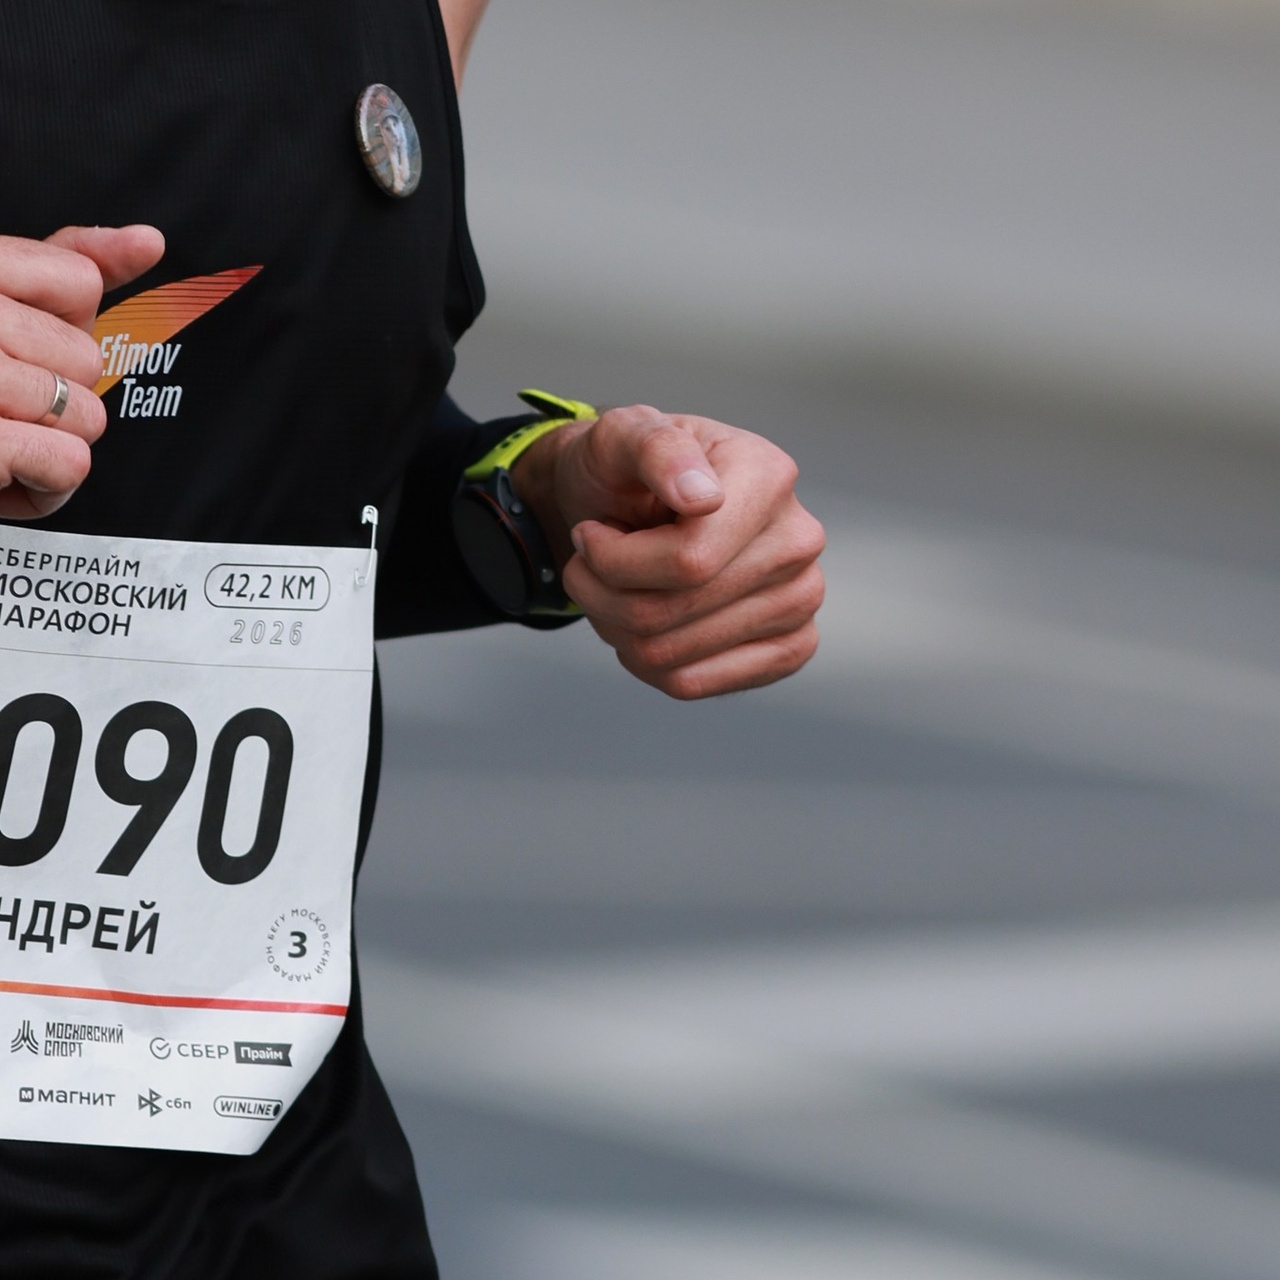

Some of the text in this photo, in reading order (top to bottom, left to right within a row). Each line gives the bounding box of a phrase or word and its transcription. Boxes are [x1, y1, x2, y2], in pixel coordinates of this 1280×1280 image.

[100, 333, 182, 376] Efimov
[120, 378, 183, 418] Team
[220, 573, 316, 602] 42,2 КМ
[229, 619, 303, 646] 2026
[266, 913, 286, 941] БЕГУ
[287, 930, 308, 959] 3
[265, 946, 313, 982] МАРАФОН
[45, 1021, 124, 1044] МОСКОВСКИЙ
[44, 1040, 83, 1058] СПОРТ
[177, 1043, 284, 1062] СБЕР Прайм
[220, 1100, 273, 1116] WINLINE
